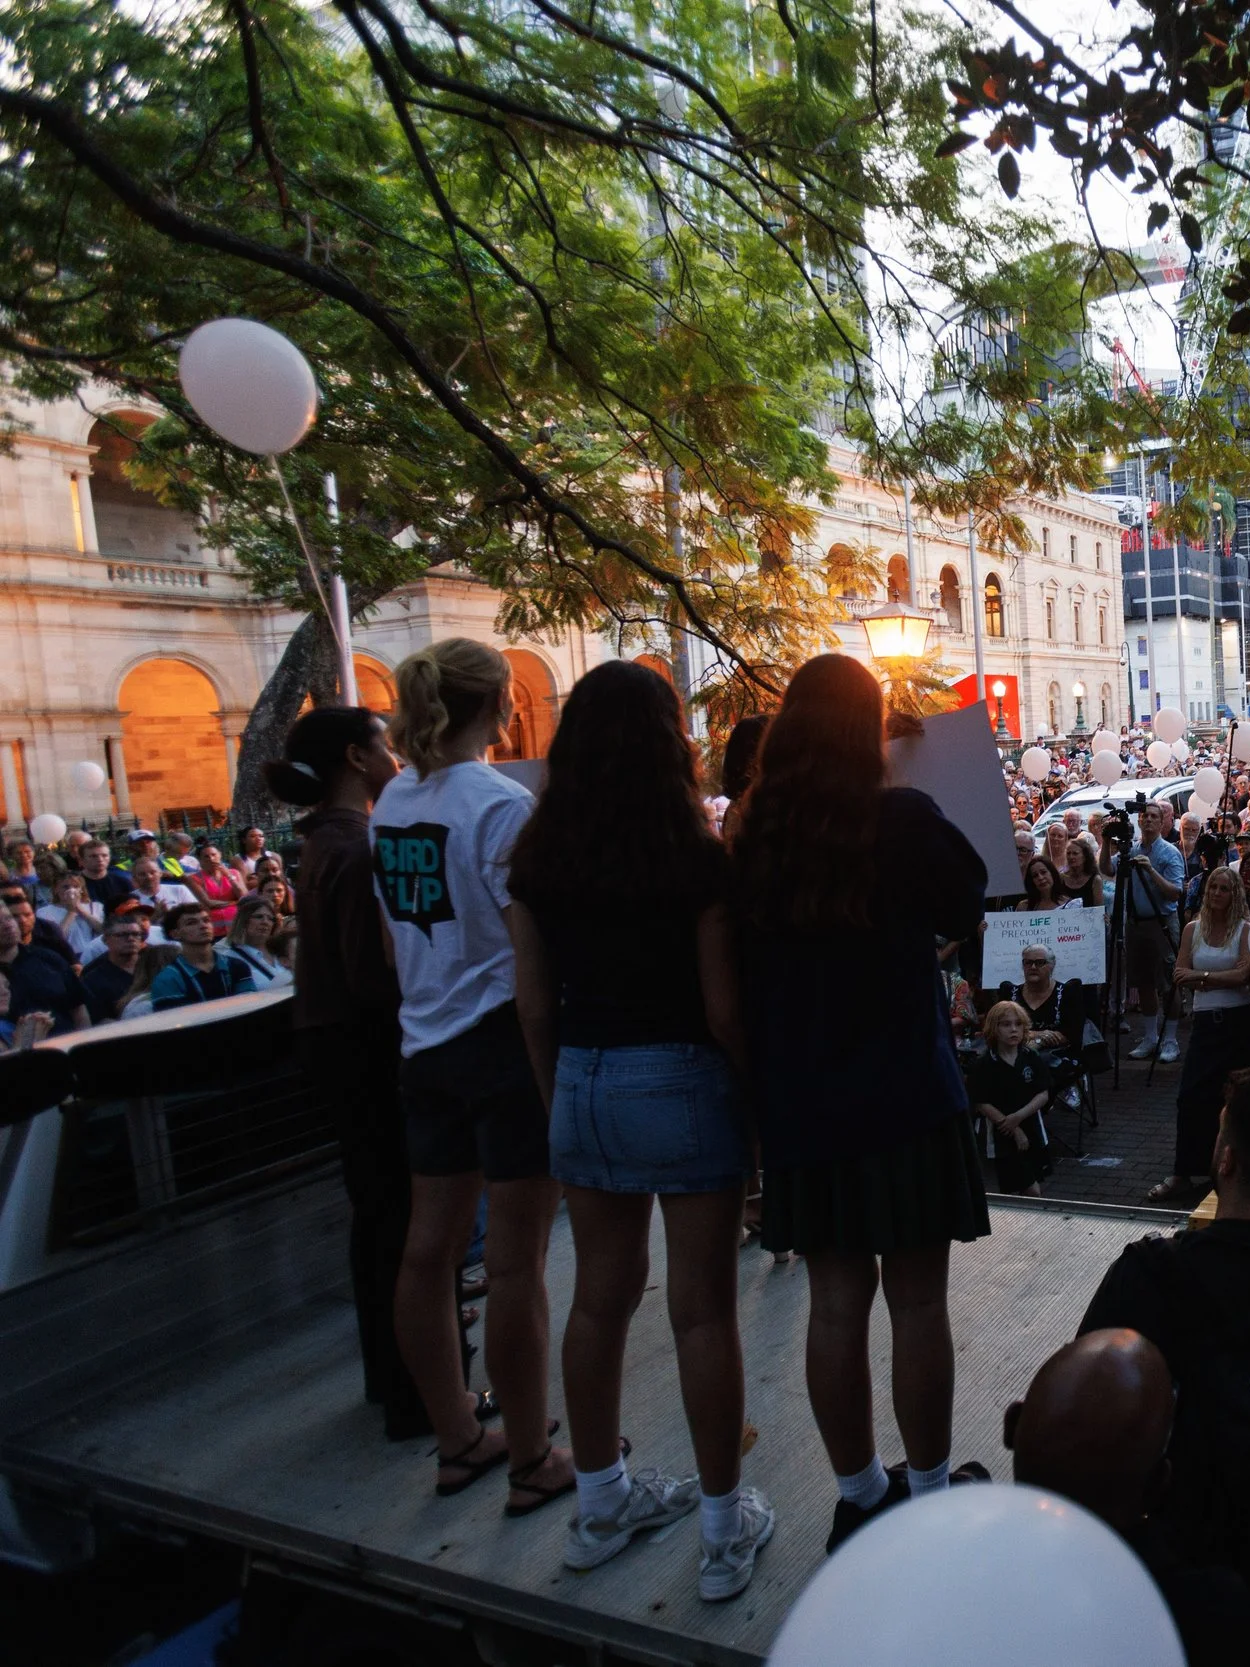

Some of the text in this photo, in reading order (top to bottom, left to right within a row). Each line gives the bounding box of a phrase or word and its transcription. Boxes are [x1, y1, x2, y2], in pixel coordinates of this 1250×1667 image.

[377, 838, 439, 873] BIRD
[993, 920, 1024, 929] EVERY
[1029, 917, 1051, 927] LIFE
[1001, 925, 1080, 938] PRECIOUS EVEN
[1019, 938, 1029, 946] IN
[1036, 937, 1052, 945] THE
